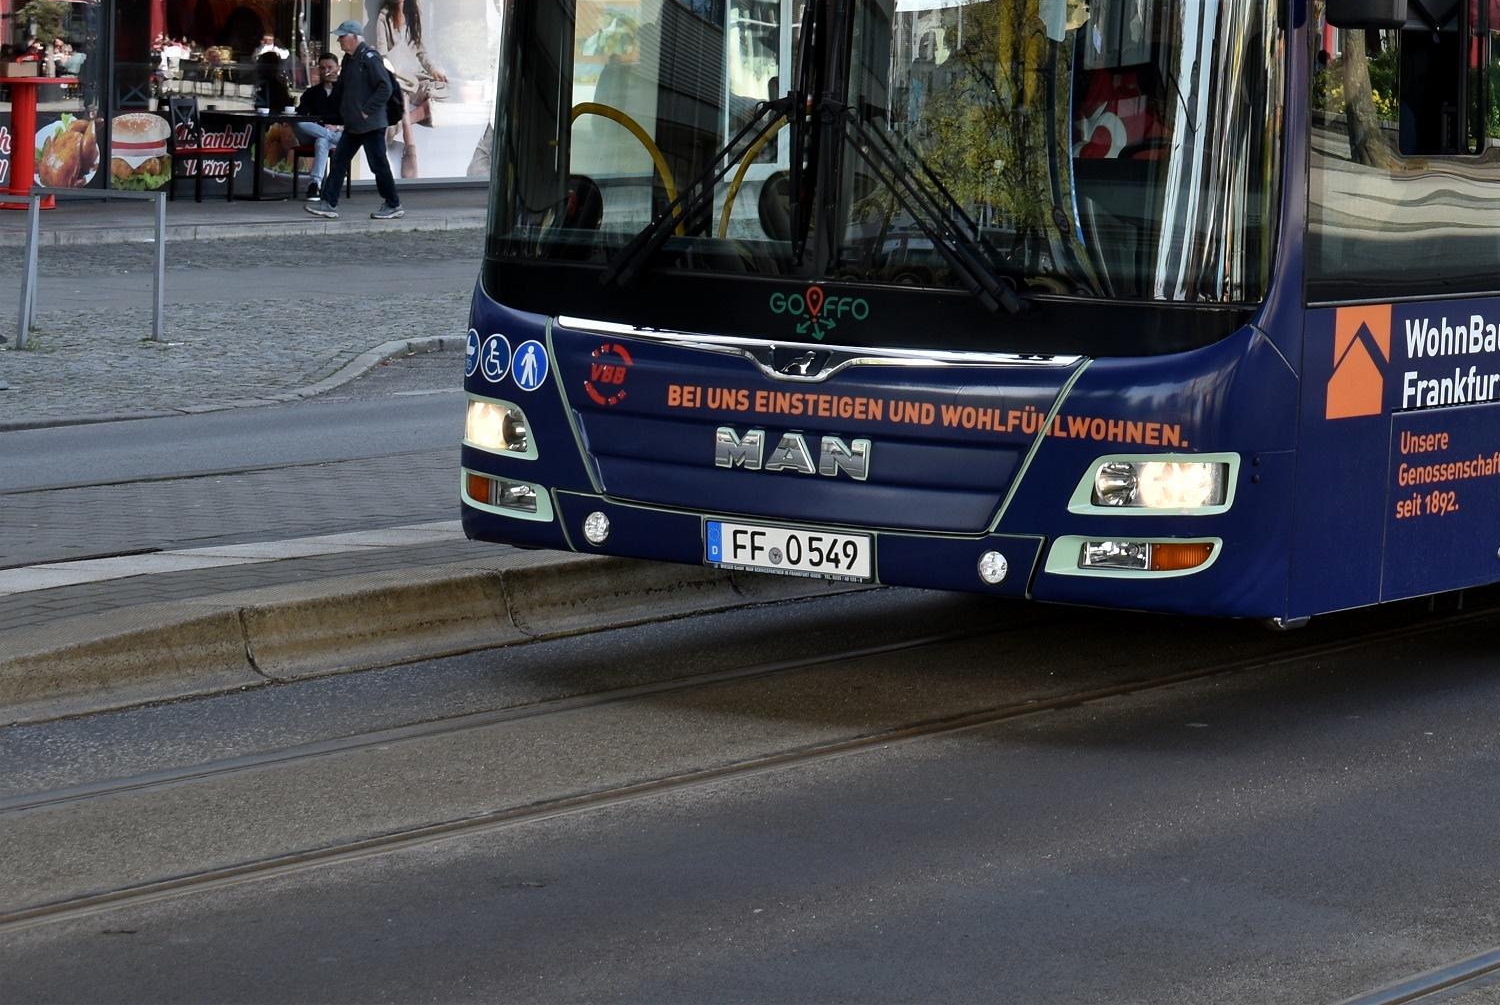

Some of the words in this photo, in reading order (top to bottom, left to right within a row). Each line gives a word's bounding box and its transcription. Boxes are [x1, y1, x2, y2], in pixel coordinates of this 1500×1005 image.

[769, 292, 805, 315] GO
[823, 296, 870, 320] FFO
[591, 363, 627, 385] VBB
[667, 384, 702, 408] BEI
[707, 387, 749, 412] UNS
[754, 390, 884, 421] EINSTEIGEN
[889, 400, 935, 425] UND
[715, 426, 872, 482] MAN
[1401, 431, 1449, 455] Unsere
[1396, 493, 1422, 519] seit
[1425, 491, 1459, 517] 1892.
[711, 546, 718, 555] D
[732, 529, 767, 561] FF
